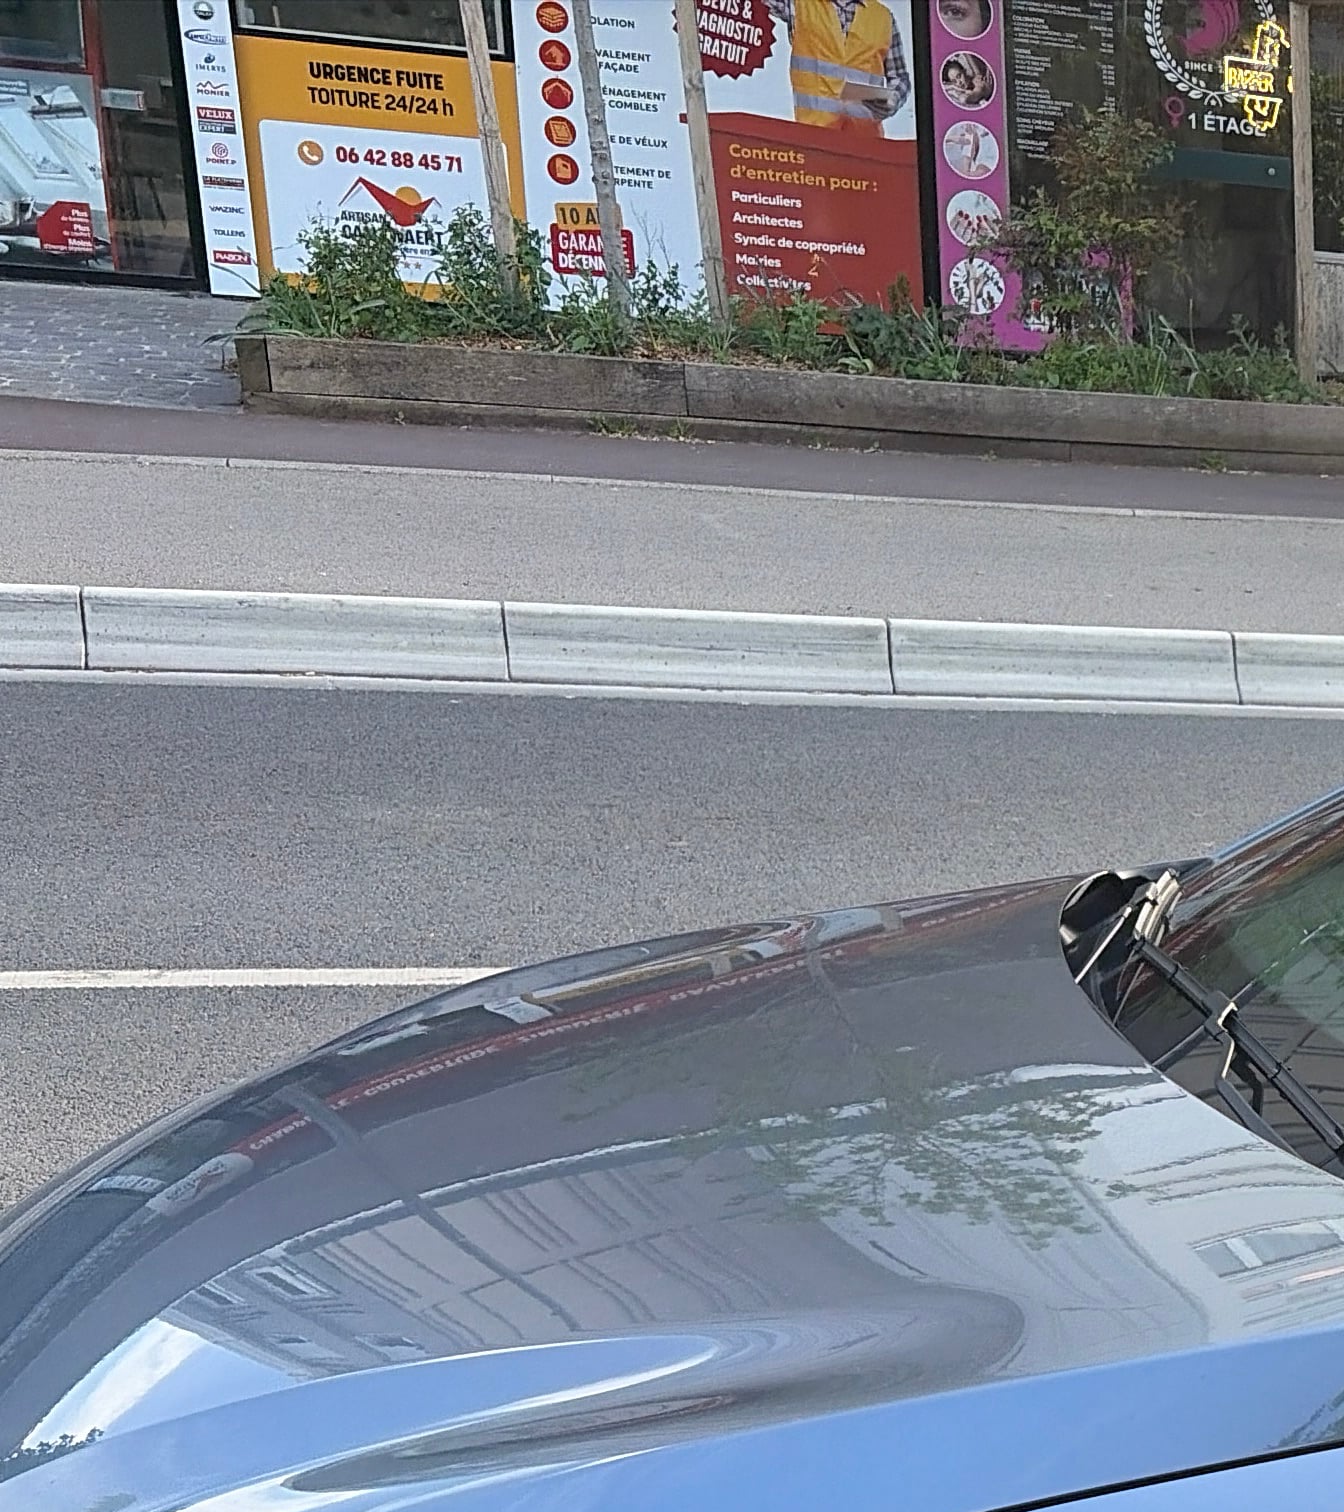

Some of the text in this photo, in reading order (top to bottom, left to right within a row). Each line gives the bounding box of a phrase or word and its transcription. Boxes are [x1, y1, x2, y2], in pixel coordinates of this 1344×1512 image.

[742, 0, 753, 20] &
[590, 16, 636, 29] OLATION
[697, 9, 763, 47] IAGNOSTIC
[595, 49, 652, 62] VALEMENT
[1184, 60, 1214, 73] SINCE
[308, 61, 444, 91] URGENCE FUITE
[196, 88, 230, 98] MONIER
[601, 86, 667, 101] ÉNAGEMENT
[307, 86, 455, 117] TOITURE 24/24 h
[608, 99, 659, 113] COMBLES
[198, 107, 234, 120] VELUX
[1187, 110, 1267, 138] 1 ÉTAGE
[618, 135, 632, 146] DE
[636, 134, 669, 149] VÉLUX
[335, 145, 463, 174] 06 42 88 45 71
[729, 143, 806, 165] Contrats
[614, 166, 672, 180] TEMENT DE
[730, 165, 826, 188] d'entretien
[830, 177, 870, 191] pour
[614, 178, 654, 190] RPENTE
[731, 190, 802, 209] Particuliers
[341, 210, 387, 225] ARTISAN
[558, 206, 580, 225] 10
[732, 211, 804, 230] Architectes
[213, 228, 246, 238] TOLLENS
[734, 232, 866, 256] Syndic de copropriété
[735, 253, 782, 268] Mairies
